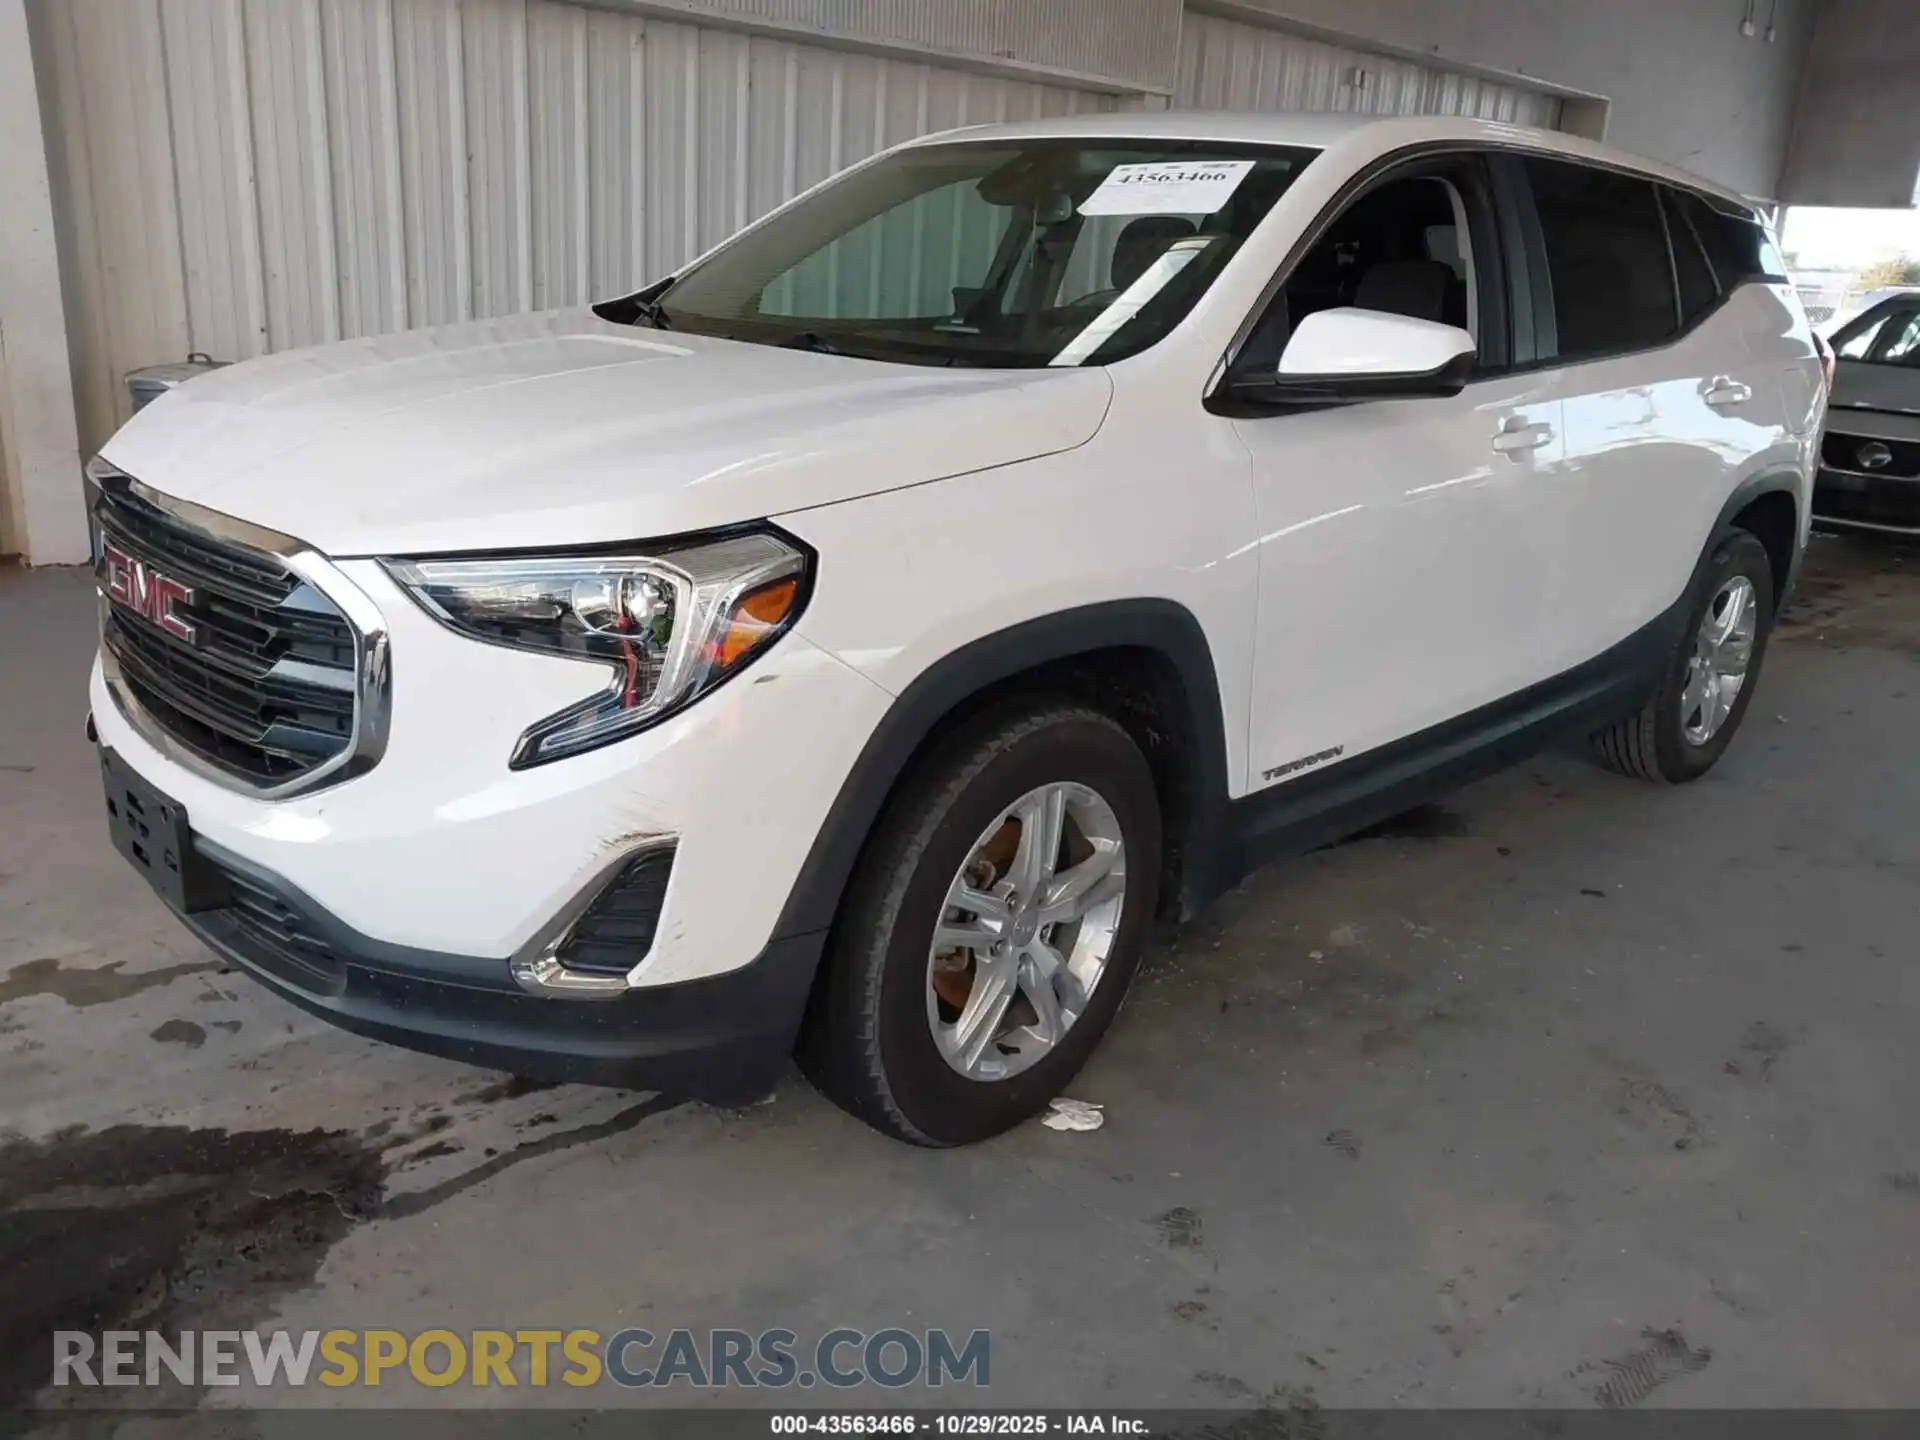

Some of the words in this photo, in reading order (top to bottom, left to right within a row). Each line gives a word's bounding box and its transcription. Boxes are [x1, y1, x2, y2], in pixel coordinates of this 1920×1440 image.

[1118, 171, 1227, 184] 43563466
[103, 542, 196, 644] GMC
[1262, 744, 1344, 781] TERRAIN
